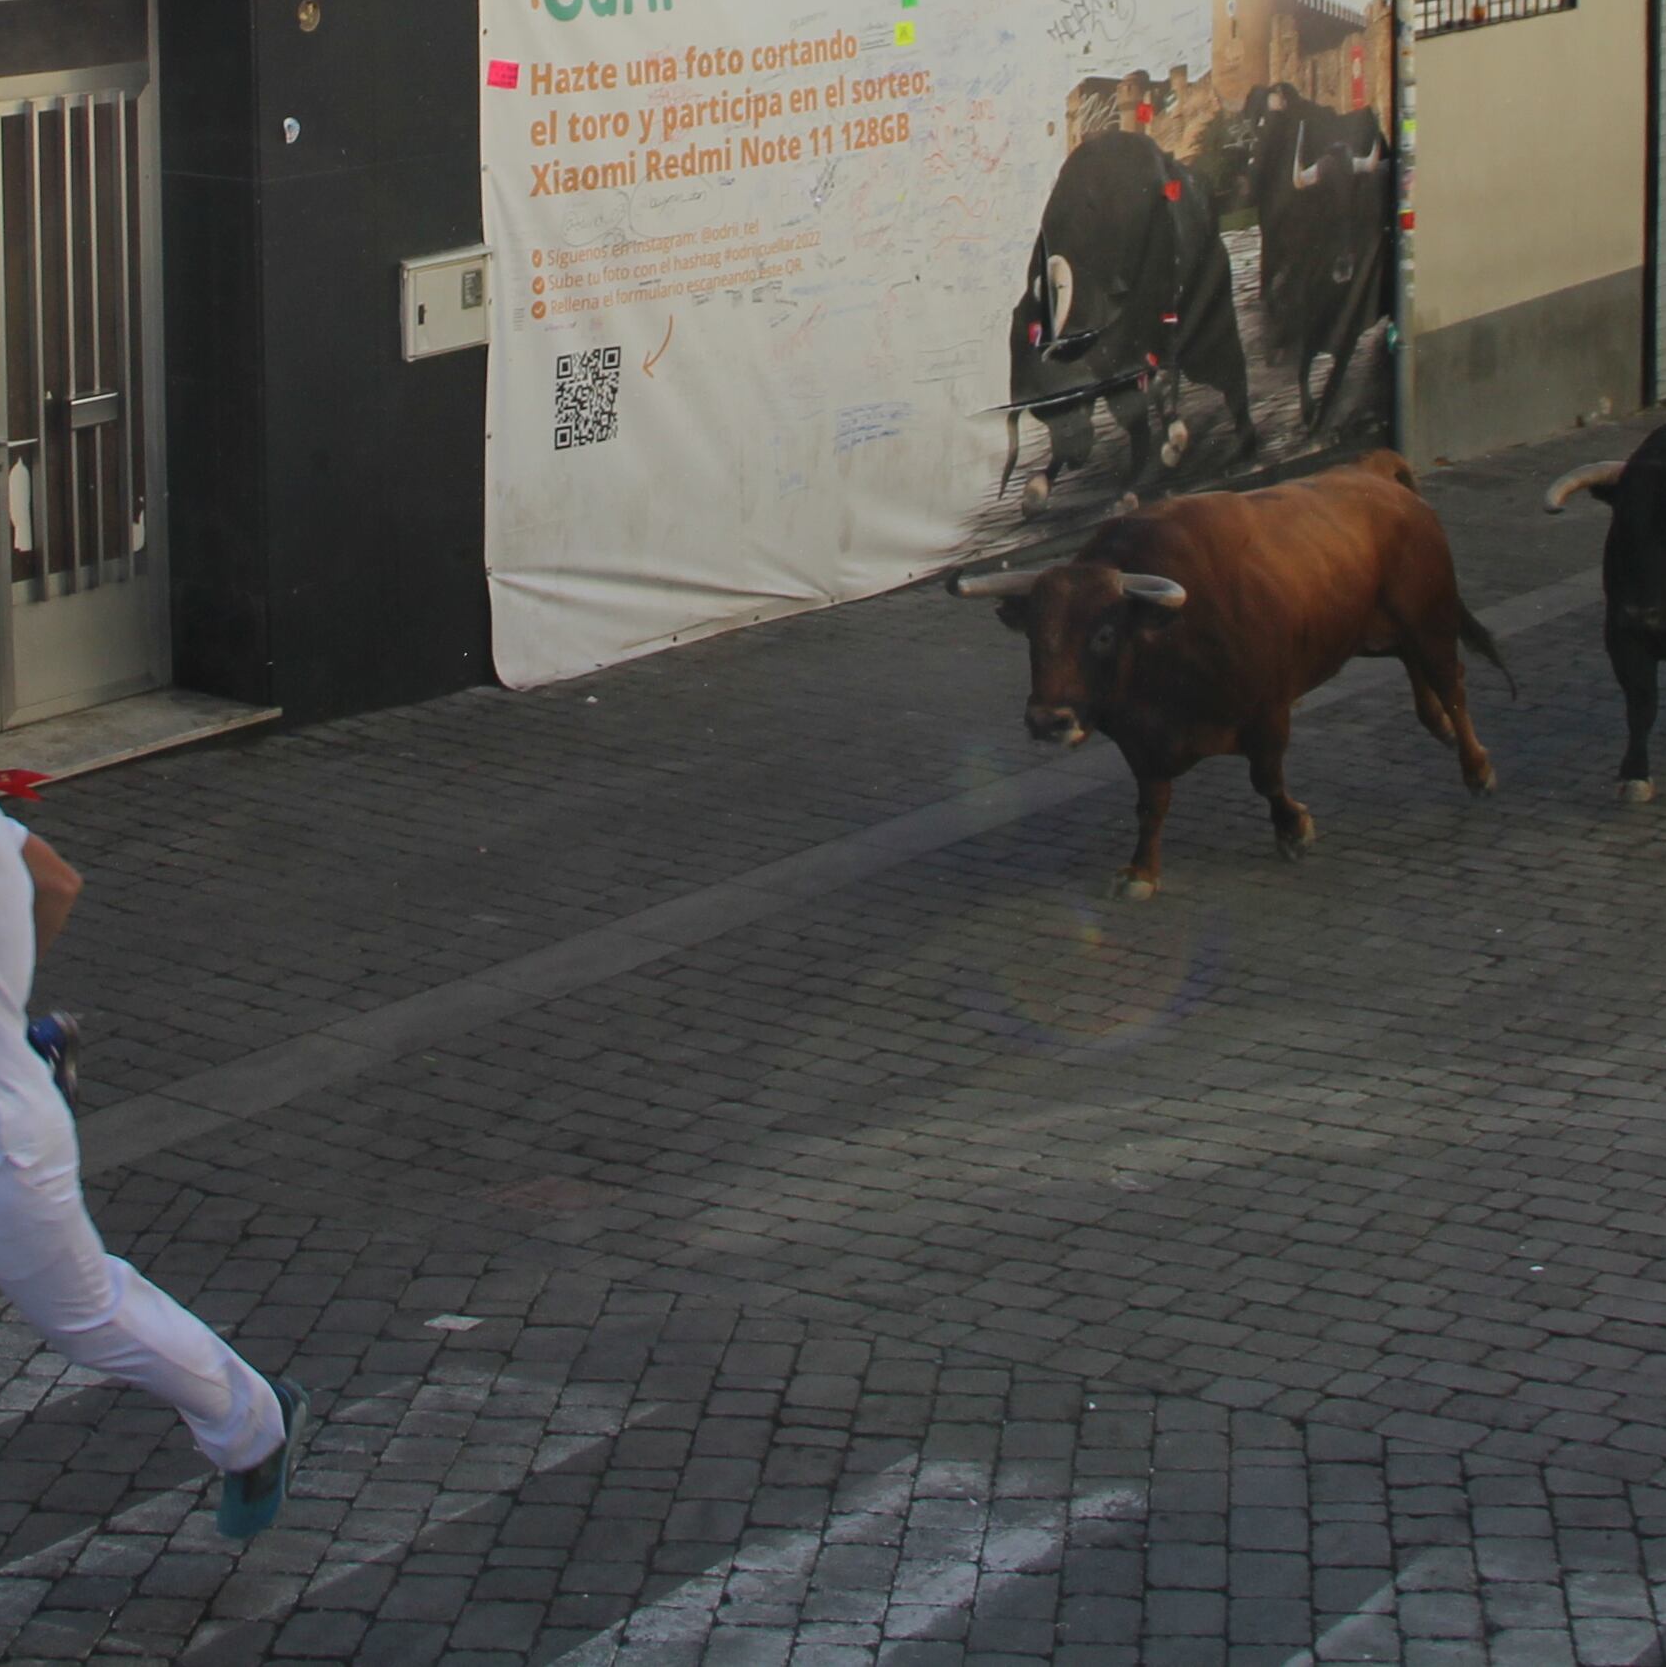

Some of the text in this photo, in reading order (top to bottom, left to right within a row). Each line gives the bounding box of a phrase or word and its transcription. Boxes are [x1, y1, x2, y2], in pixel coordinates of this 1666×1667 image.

[529, 60, 618, 96] Hazte
[626, 53, 678, 87] una
[683, 44, 745, 80] foto
[751, 29, 859, 72] cortando
[529, 68, 932, 147] el toro y participa en el sorteo:
[528, 111, 911, 198] Xiaomi Redmi Note 11 128GB
[547, 273, 584, 291] Sube
[603, 265, 631, 283] foto
[633, 263, 657, 279] con
[660, 257, 672, 275] el
